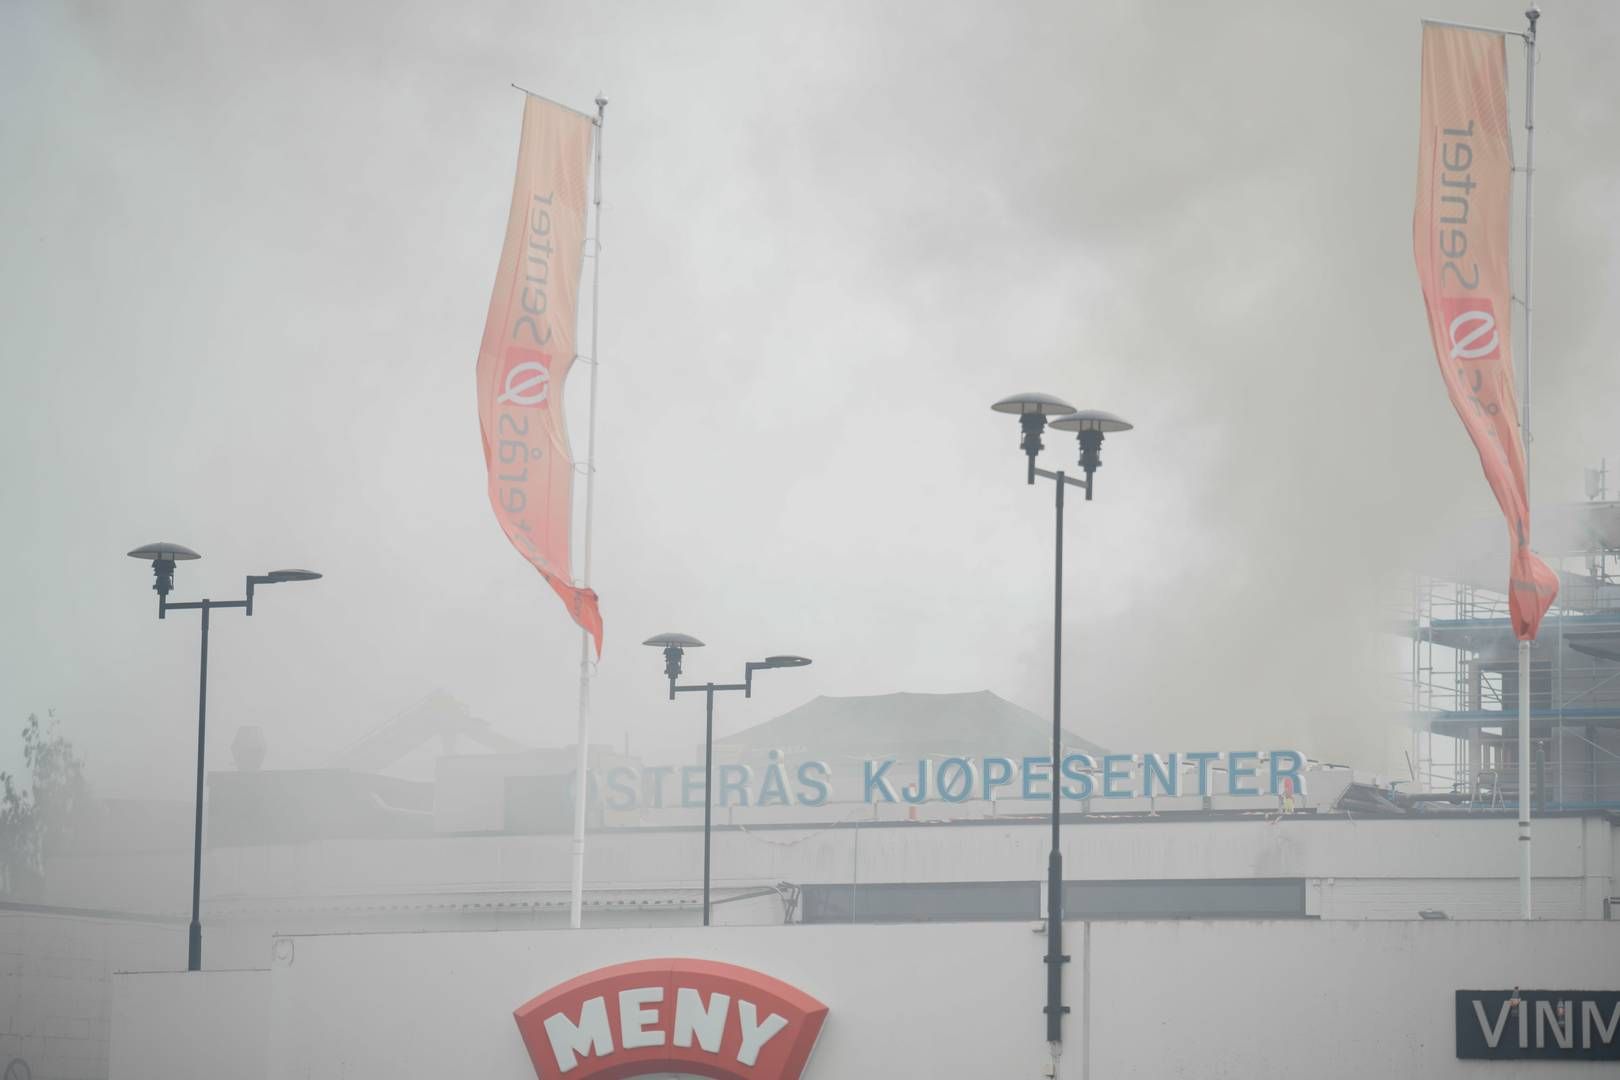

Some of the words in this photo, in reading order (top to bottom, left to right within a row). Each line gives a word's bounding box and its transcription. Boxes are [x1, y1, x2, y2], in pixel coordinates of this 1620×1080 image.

[863, 750, 1306, 804] KJØPESENTER
[543, 986, 790, 1073] MENY
[1472, 1000, 1620, 1049] VINM
